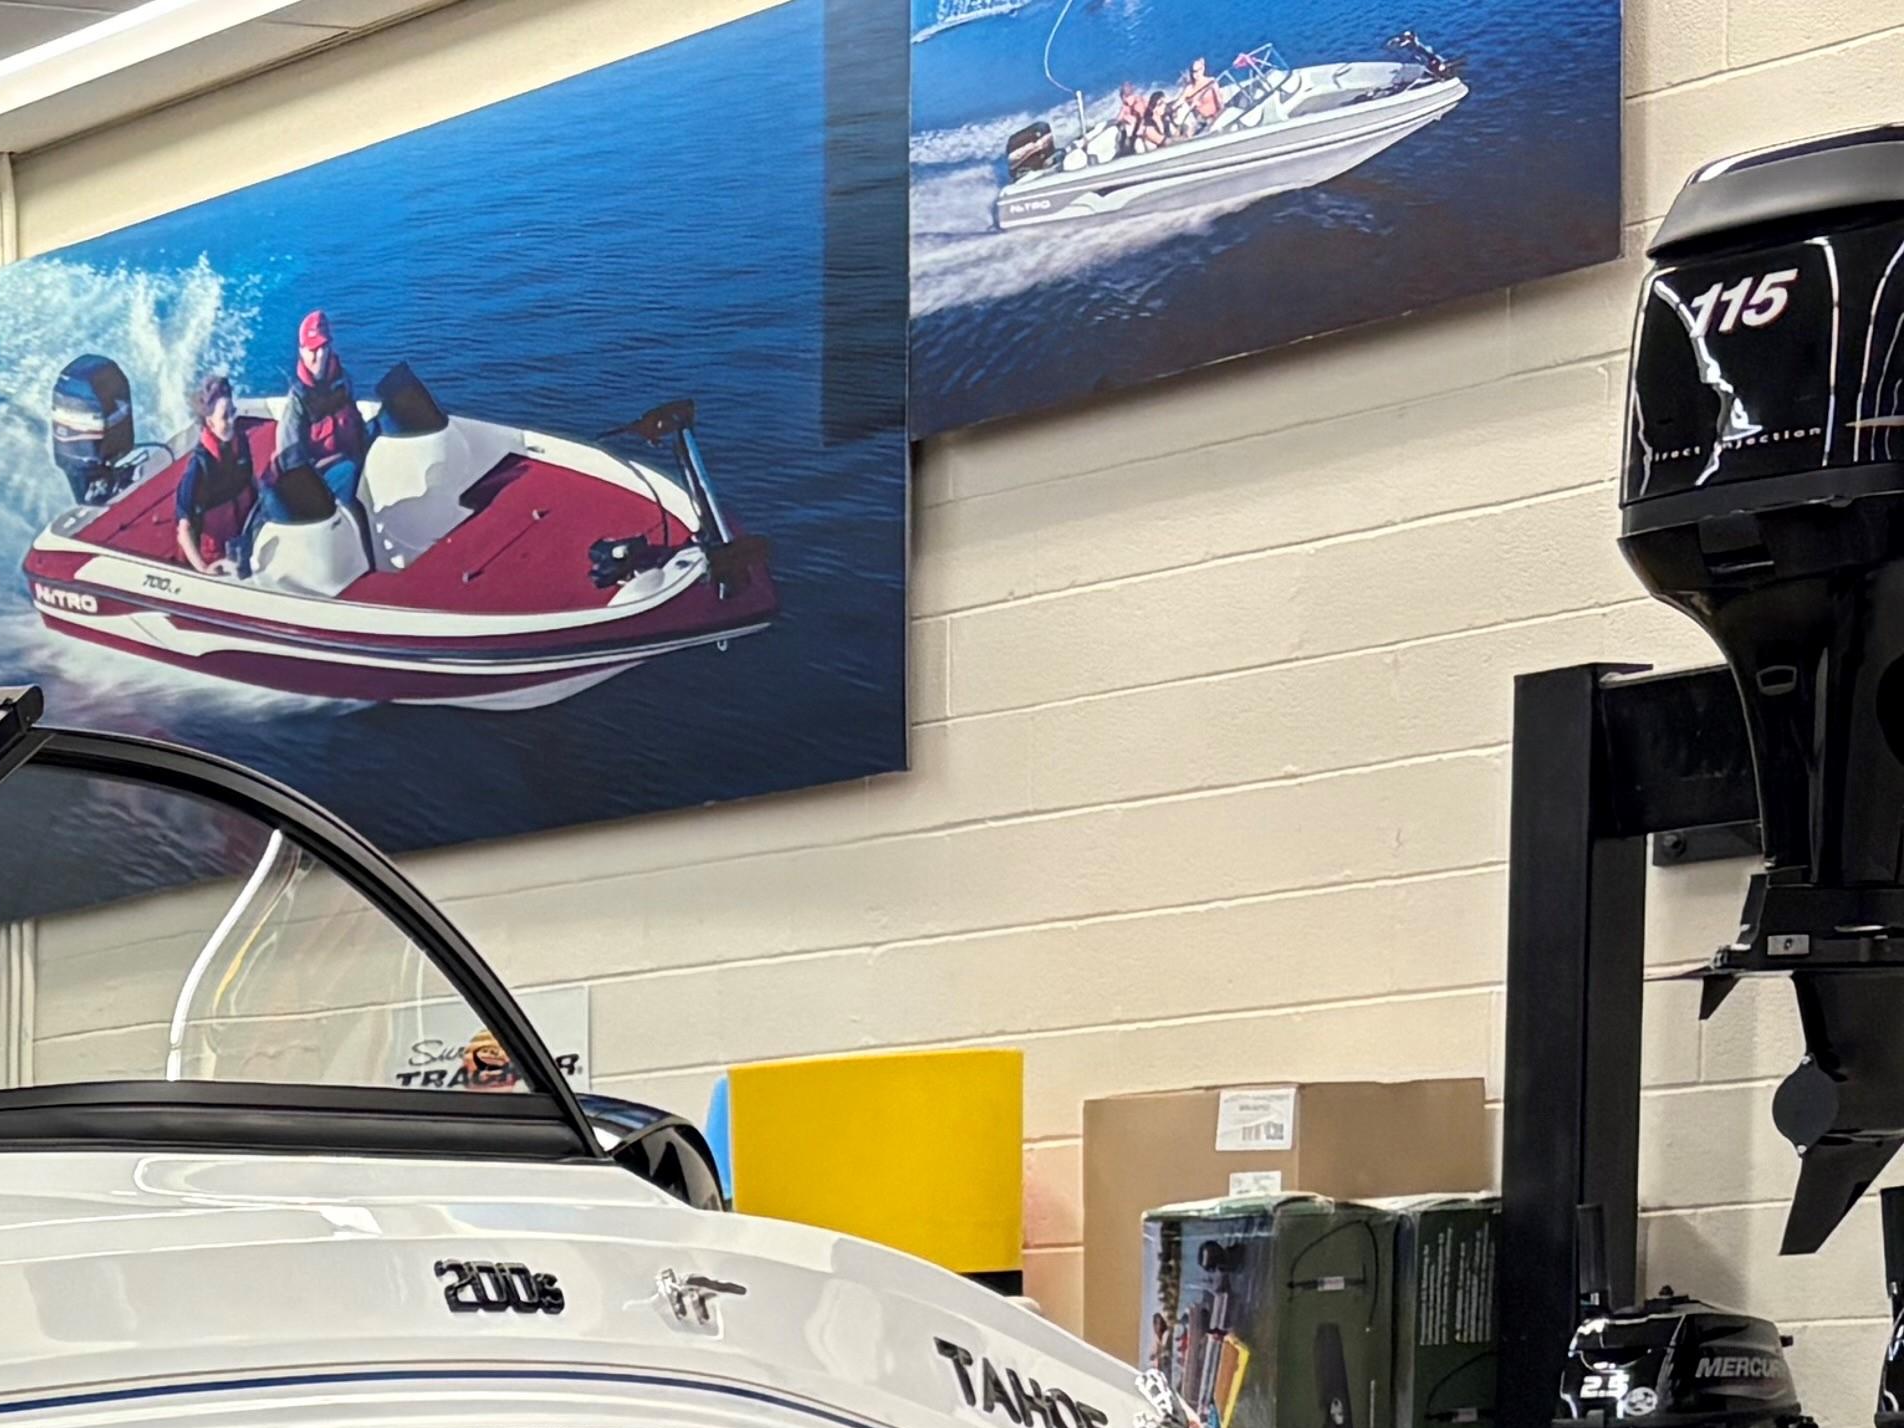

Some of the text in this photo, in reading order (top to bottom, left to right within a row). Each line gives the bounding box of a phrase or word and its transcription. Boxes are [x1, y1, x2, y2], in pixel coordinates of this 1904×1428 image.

[1691, 268, 1800, 338] 115
[1645, 427, 1822, 462] irect njection
[34, 582, 99, 614] NITRO
[434, 1258, 566, 1315] 200s
[1580, 1374, 1630, 1399] 2.5
